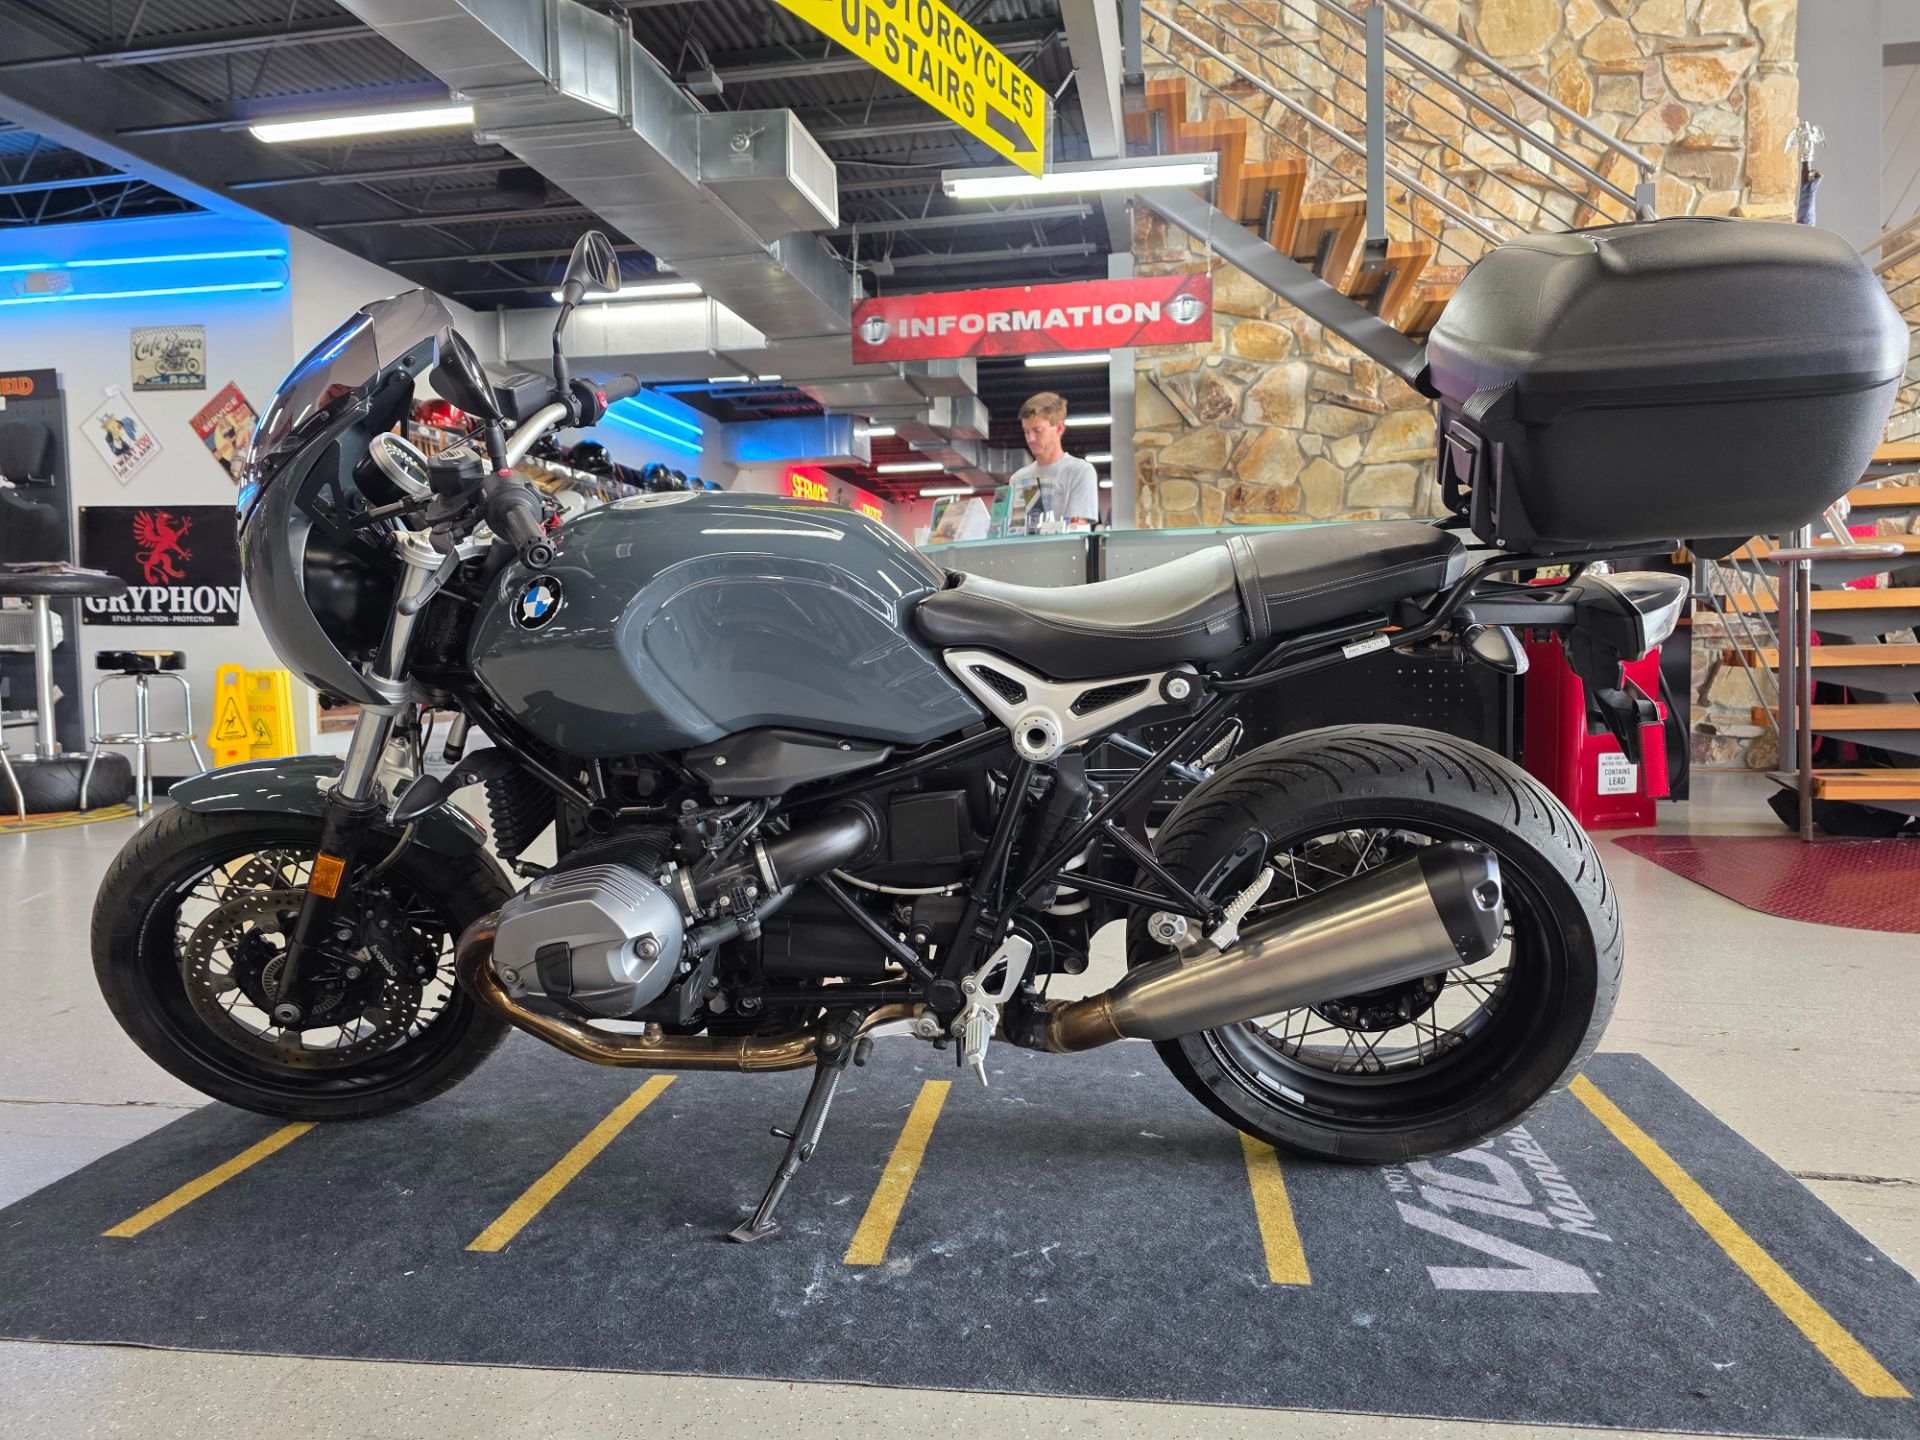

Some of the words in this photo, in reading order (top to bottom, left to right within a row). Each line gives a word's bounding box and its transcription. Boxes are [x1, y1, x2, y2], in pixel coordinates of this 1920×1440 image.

[841, 0, 976, 119] UPSTAIRS
[884, 0, 1034, 119] TORCYCLES
[899, 301, 1162, 338] INFORMATION
[201, 396, 239, 433] SERVICE
[791, 473, 829, 502] SERVICE
[85, 586, 240, 614] GRYPHON
[247, 704, 277, 713] AUTION
[1609, 776, 1626, 785] LEAD
[370, 944, 398, 977] brembo
[1380, 1163, 1413, 1194] MOT
